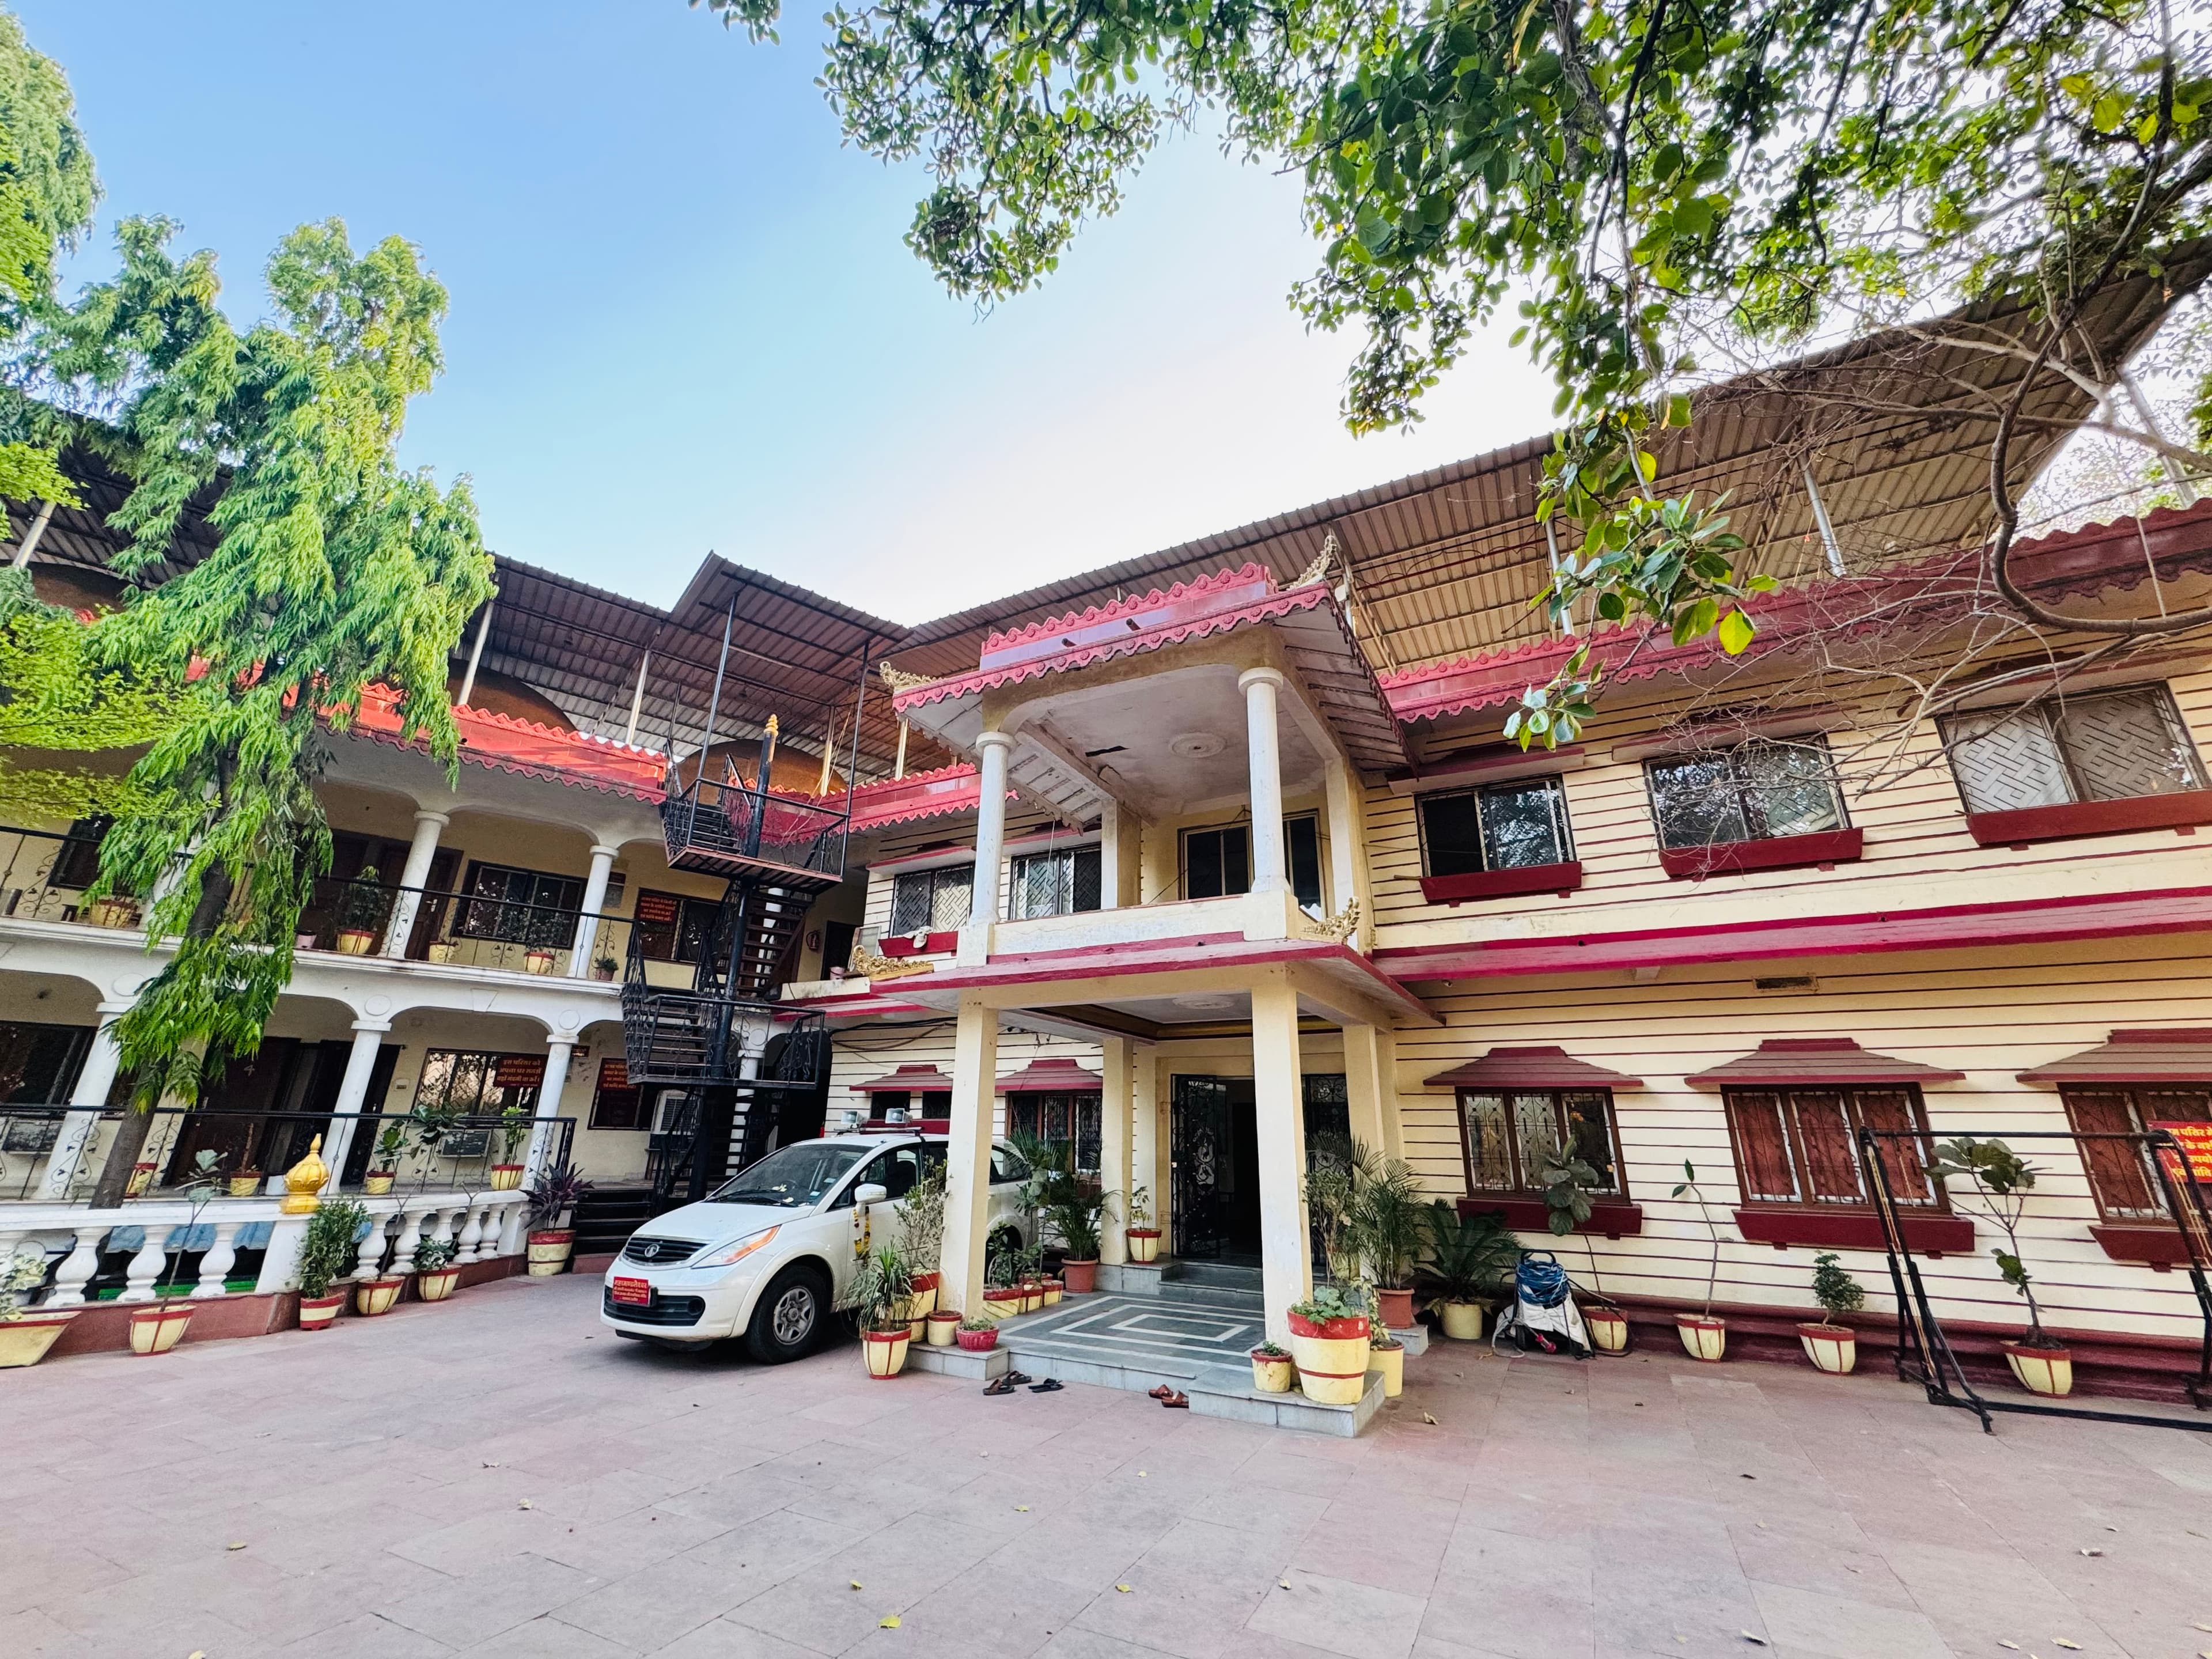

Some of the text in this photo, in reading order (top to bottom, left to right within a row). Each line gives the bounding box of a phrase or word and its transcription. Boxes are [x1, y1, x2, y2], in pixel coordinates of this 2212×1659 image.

[244, 1065, 255, 1077] 4
[2180, 1126, 2205, 1137] परिसर
[2185, 1139, 2196, 1150] के
[2187, 1153, 2212, 1164] उपयो
